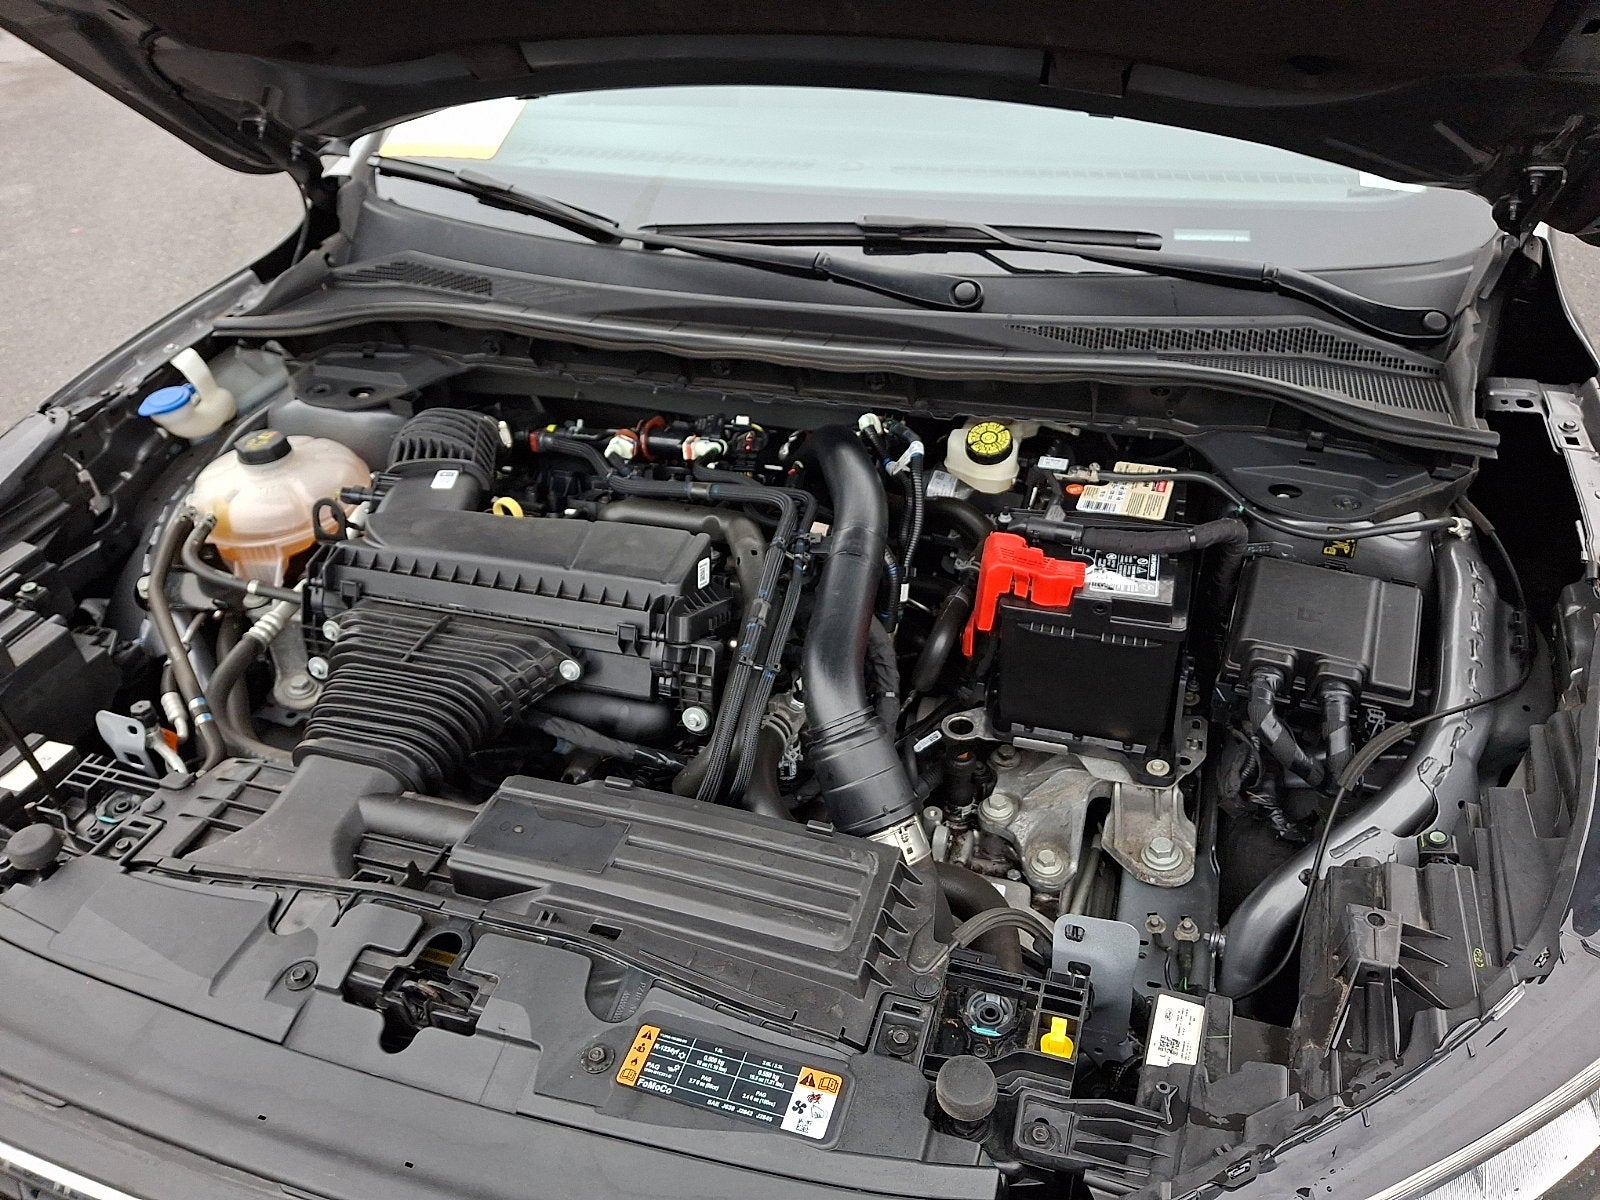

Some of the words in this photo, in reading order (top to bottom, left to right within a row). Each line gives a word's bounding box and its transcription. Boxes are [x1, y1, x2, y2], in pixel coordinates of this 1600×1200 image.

[654, 1043, 680, 1056] R-1234yf
[645, 1062, 661, 1071] PAG
[637, 1078, 673, 1095] FoMoCo
[755, 1090, 767, 1098] PAG
